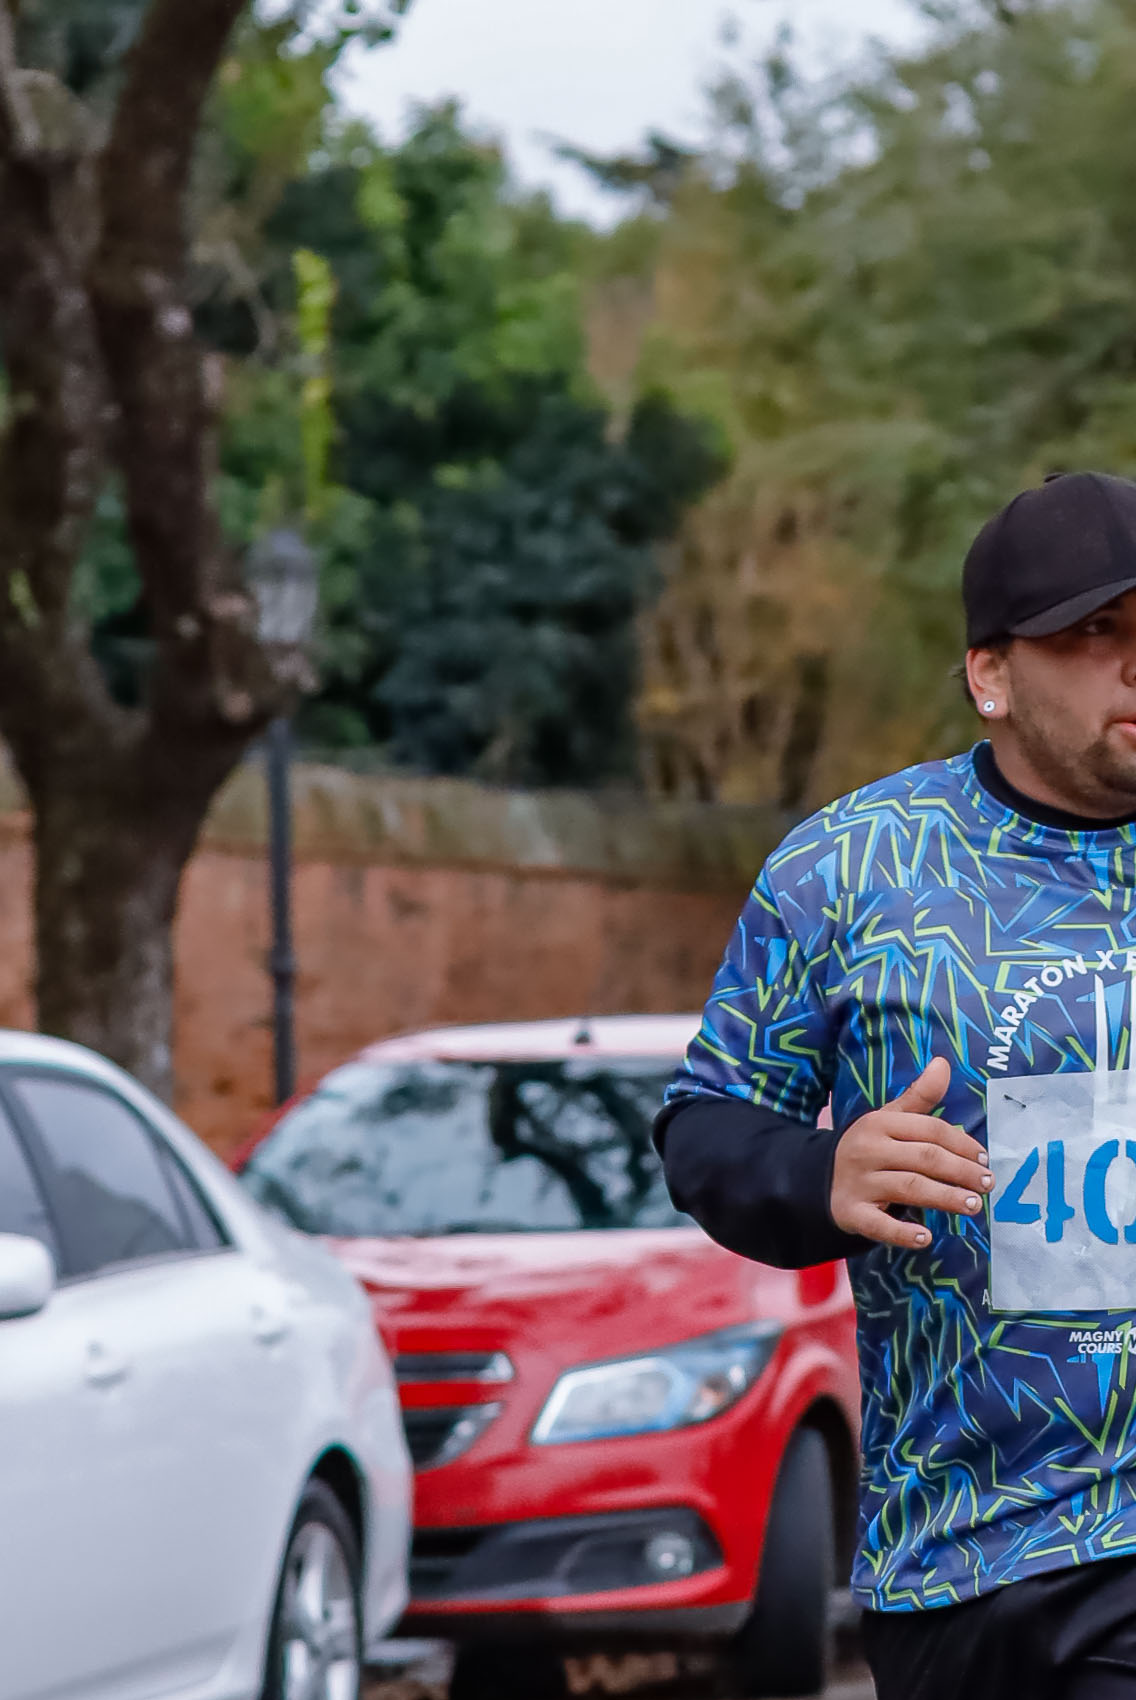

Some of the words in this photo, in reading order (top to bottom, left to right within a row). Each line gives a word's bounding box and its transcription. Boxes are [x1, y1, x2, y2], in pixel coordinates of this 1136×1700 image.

[987, 953, 1088, 1071] MARATÓN
[1095, 950, 1118, 971] X
[1068, 1330, 1123, 1343] MAGNY
[1077, 1342, 1123, 1354] COURS
